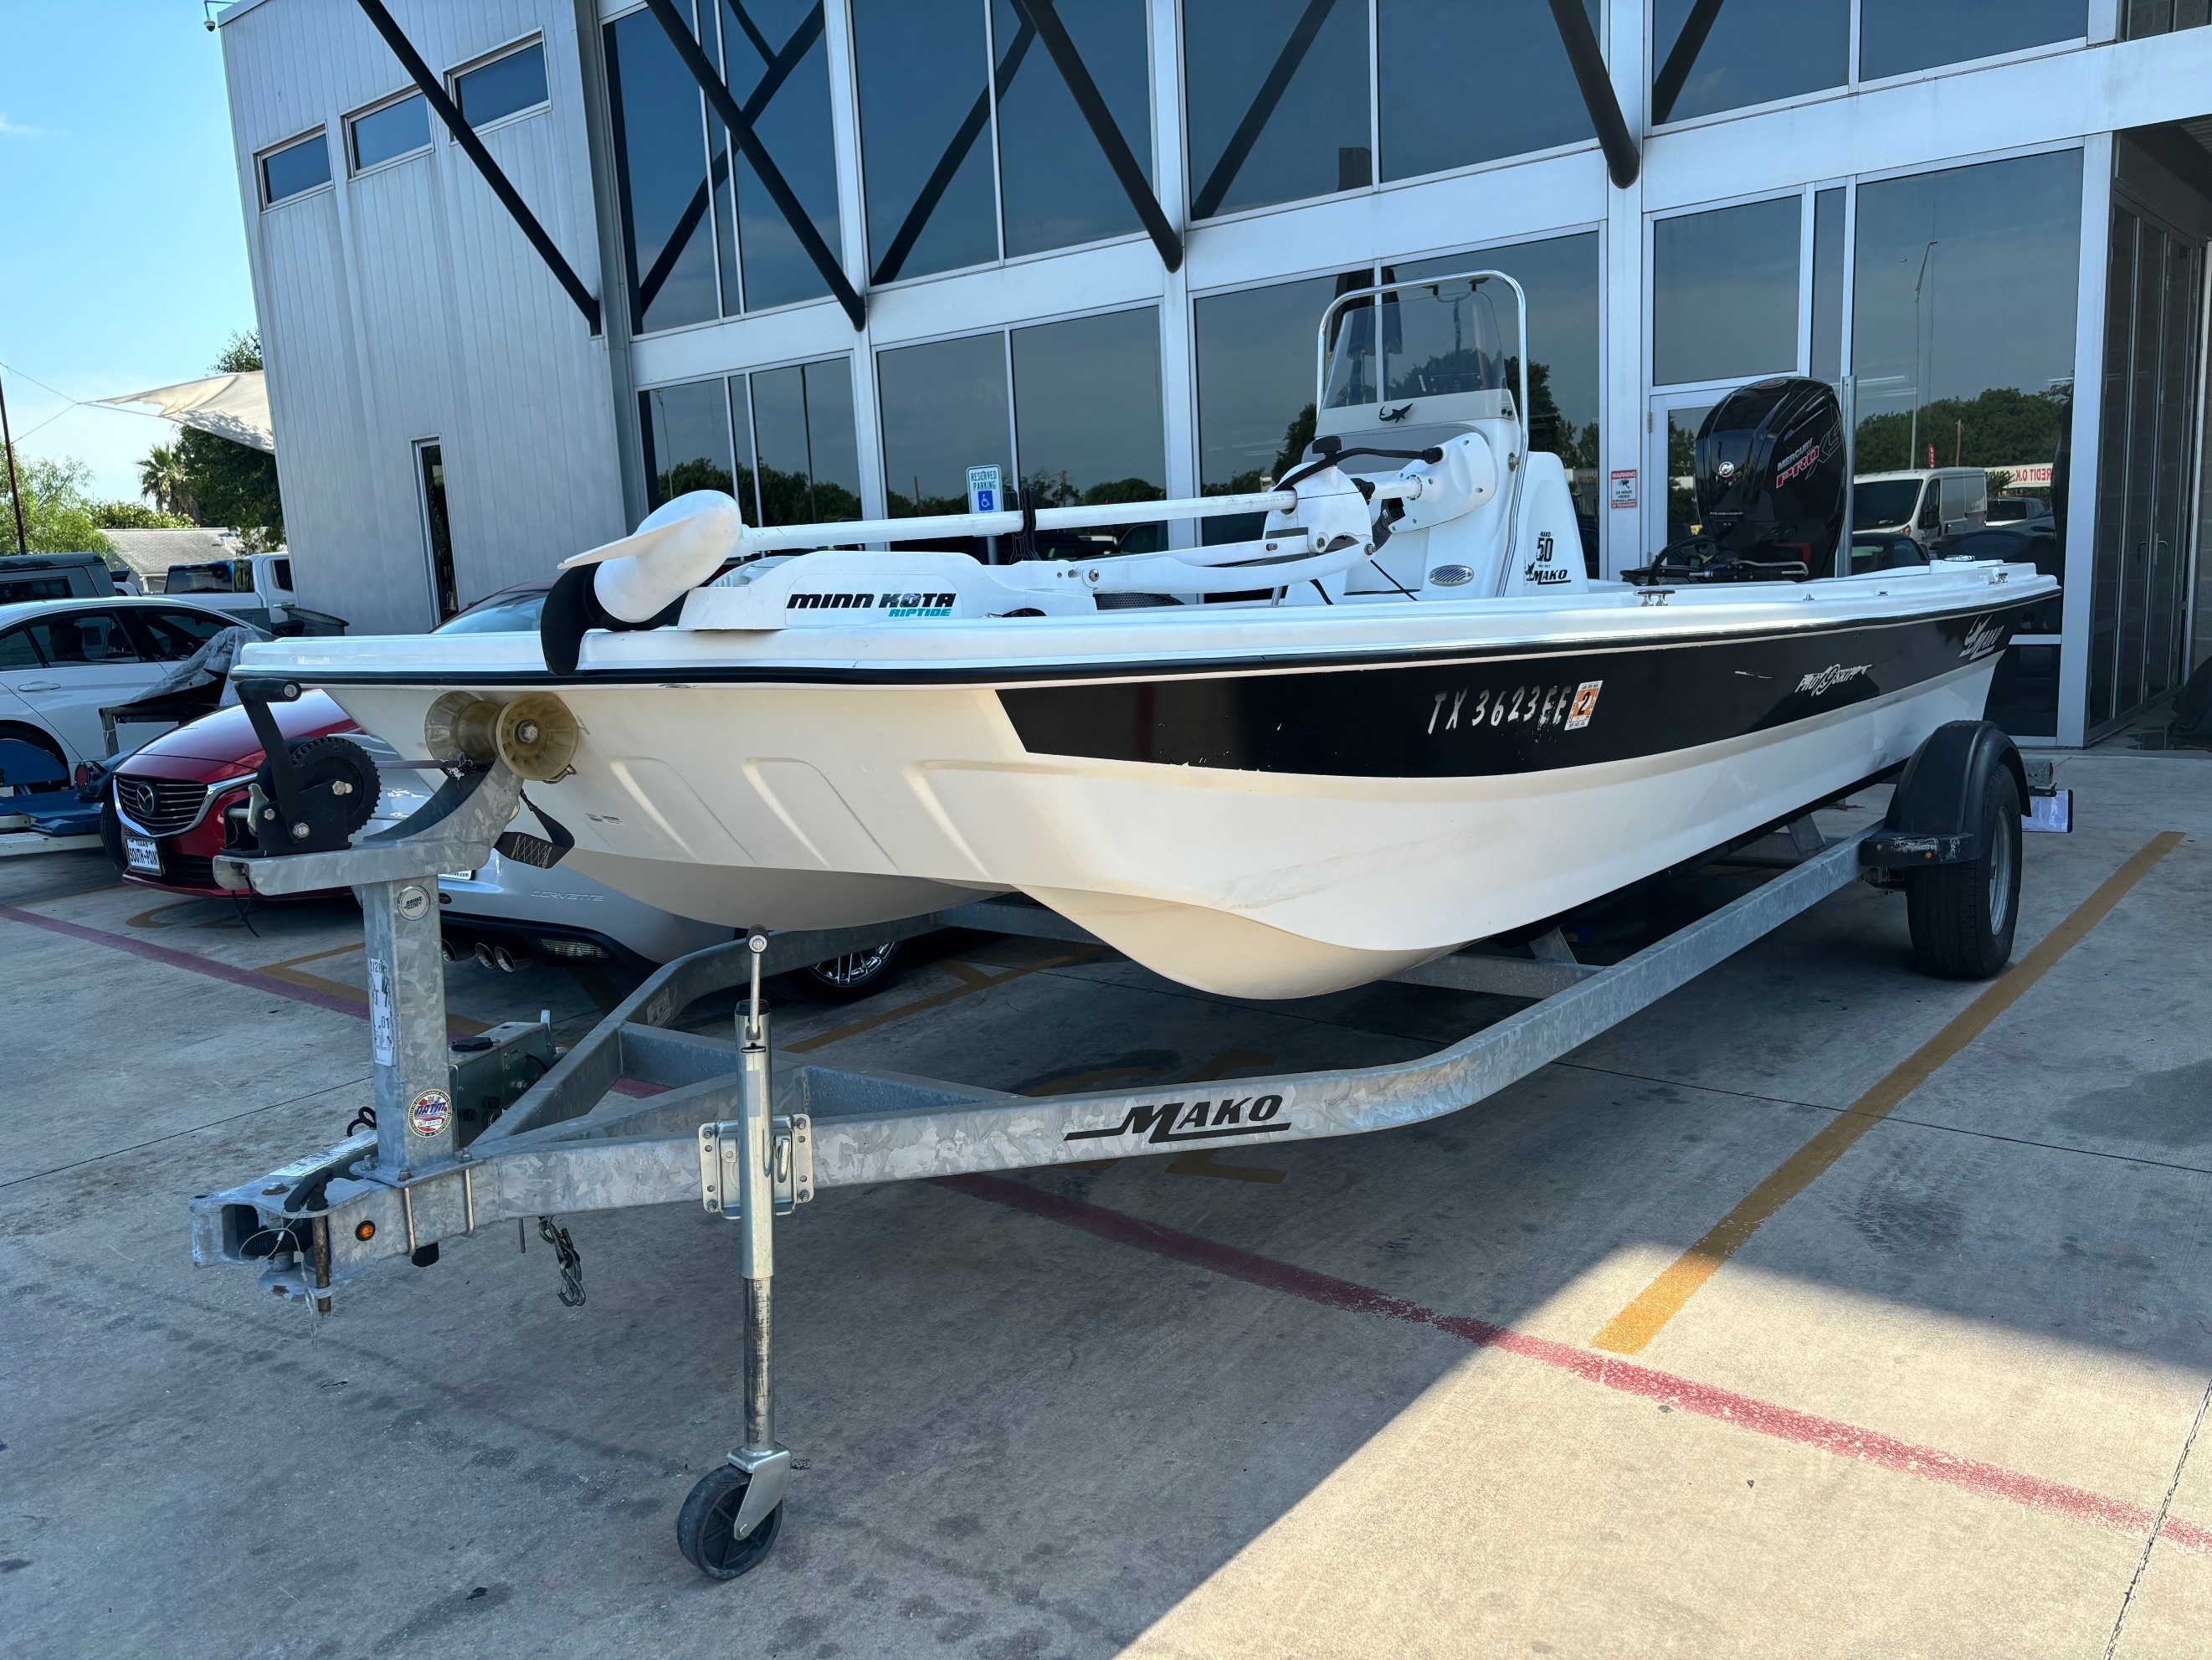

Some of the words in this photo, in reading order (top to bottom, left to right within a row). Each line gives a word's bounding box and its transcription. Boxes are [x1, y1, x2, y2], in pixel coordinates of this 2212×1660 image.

[1778, 437, 1813, 471] MERCURY
[971, 470, 997, 481] RESERVED
[1776, 445, 1819, 489] PRO
[973, 481, 996, 491] PARKING
[1536, 537, 1553, 562] 50
[1532, 569, 1571, 585] MAKO
[787, 594, 875, 609] MINN
[879, 594, 957, 609] KOTA
[889, 608, 952, 617] RIPTIDE
[1428, 687, 1468, 735] TX
[1577, 691, 1591, 716] 2
[531, 890, 605, 902] CORVETTE
[1096, 1095, 1292, 1143] MAKO
